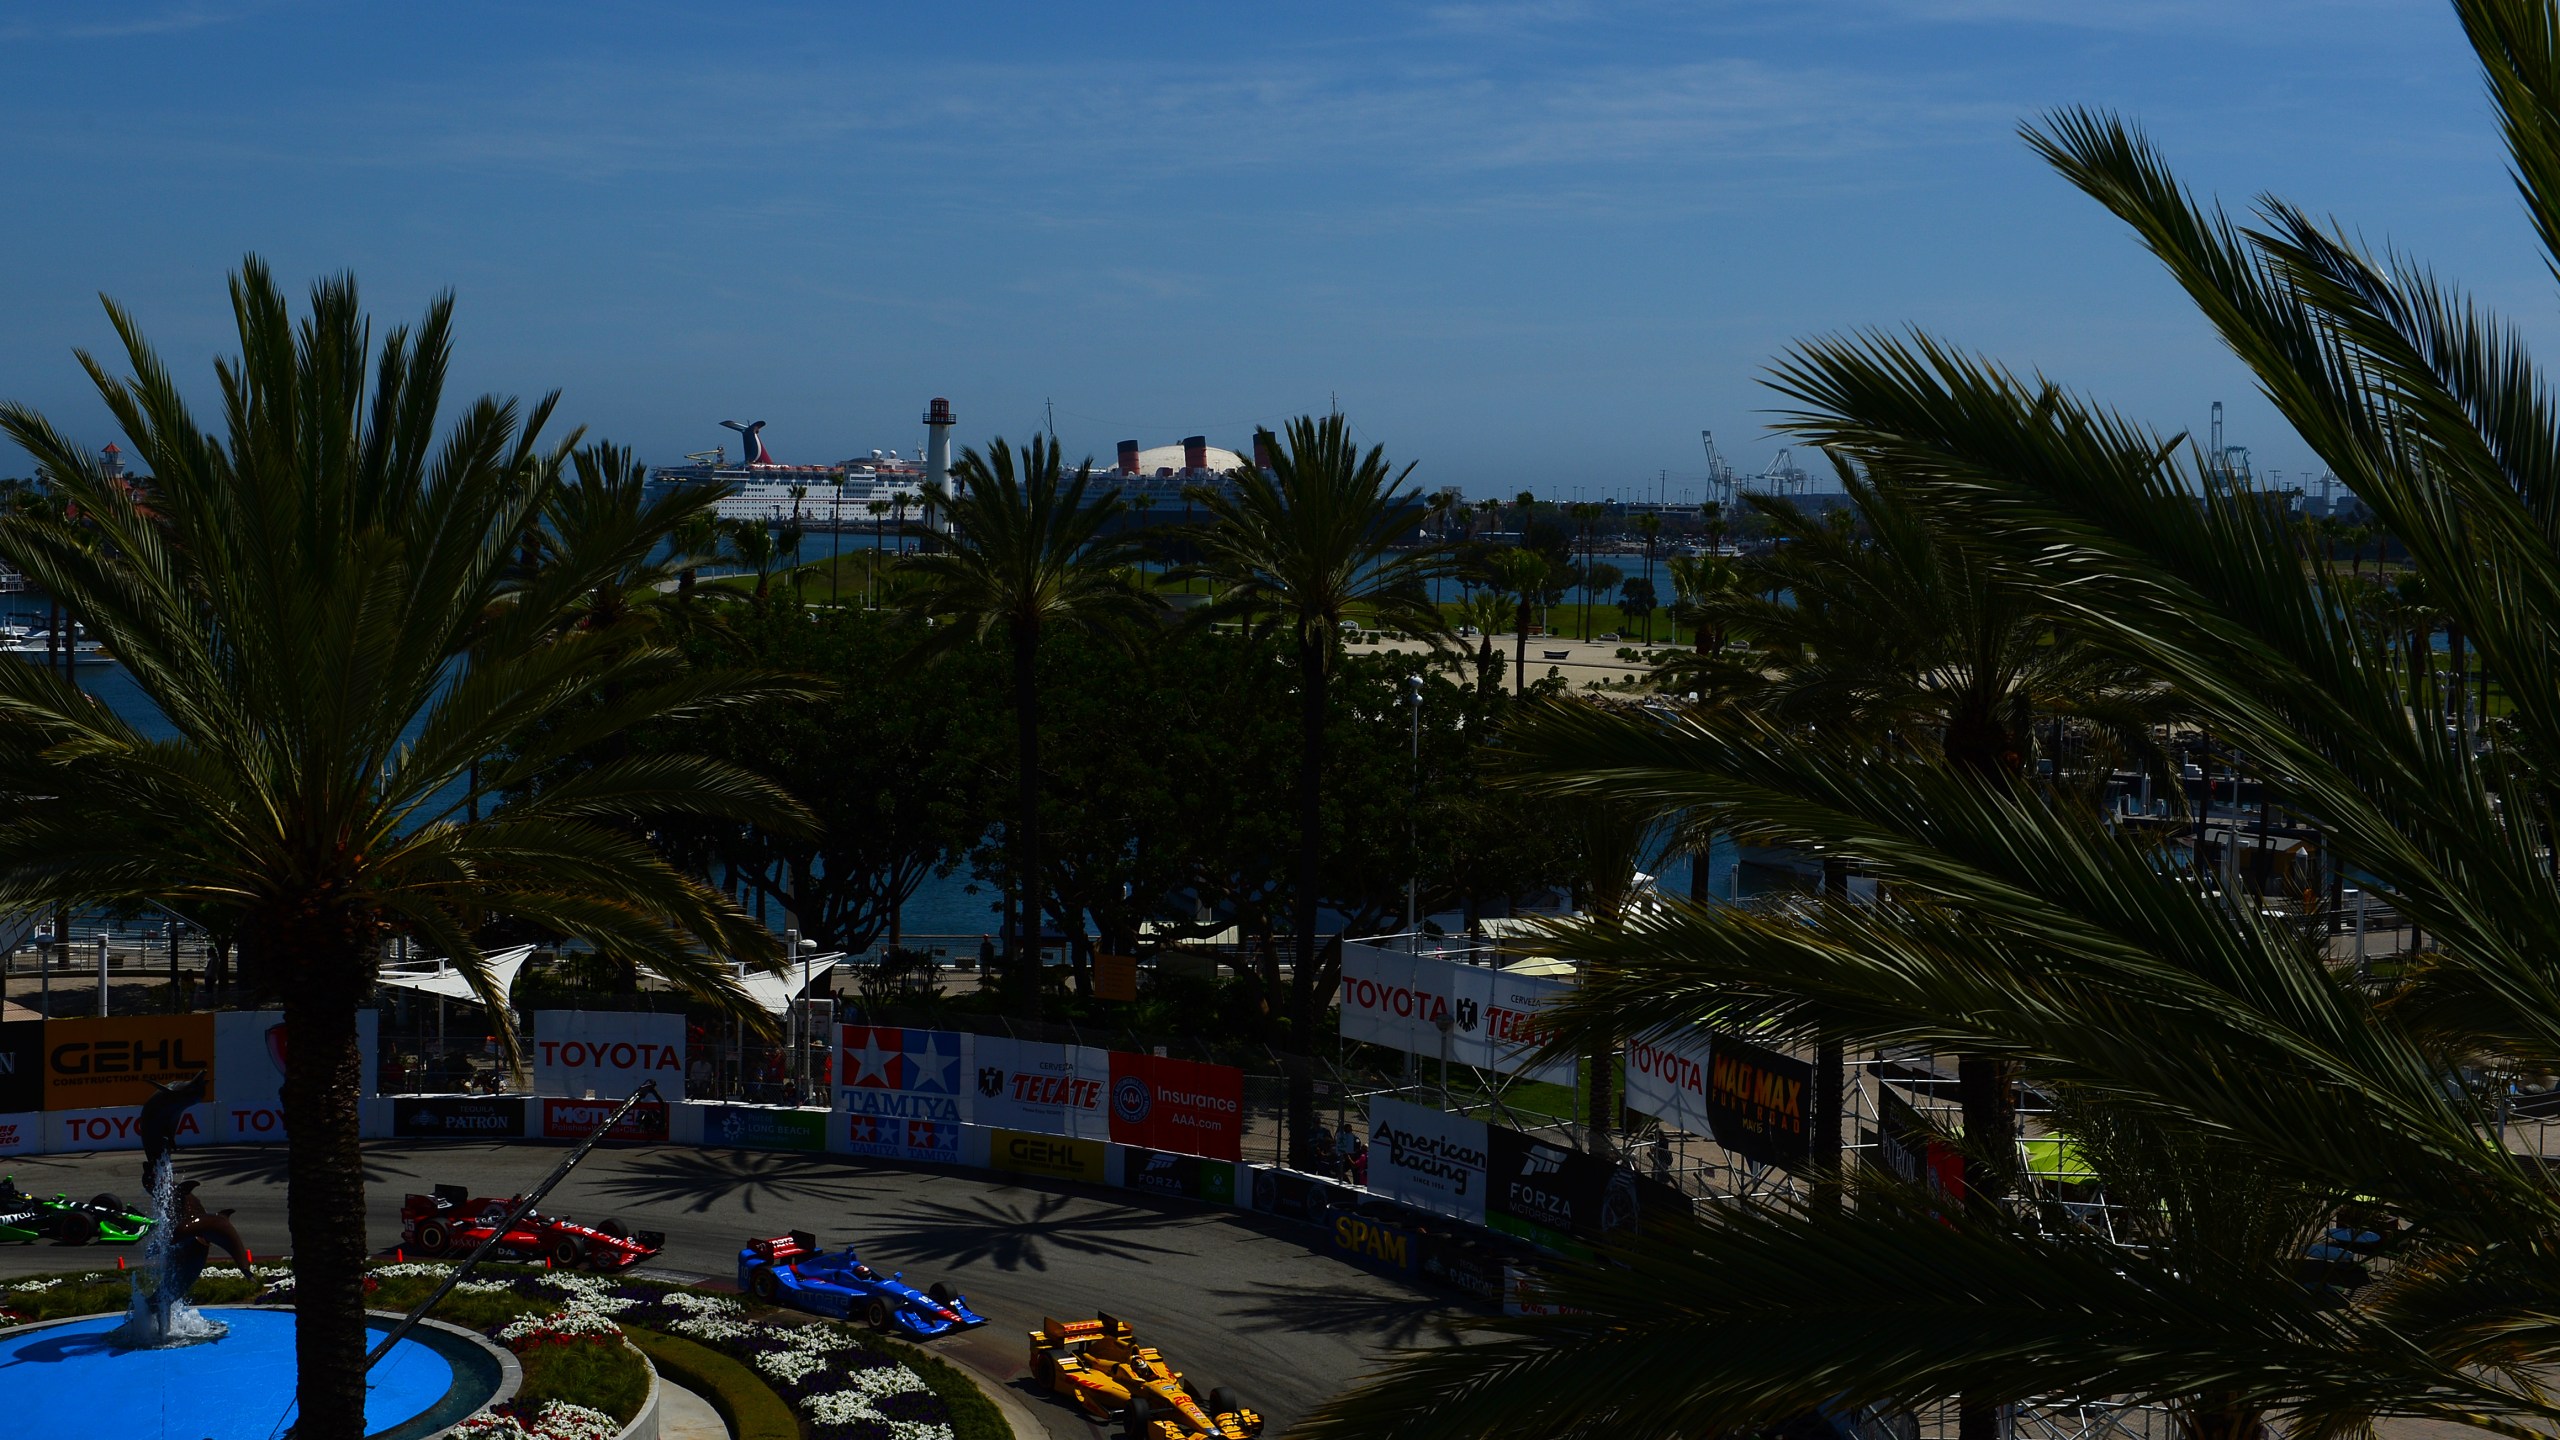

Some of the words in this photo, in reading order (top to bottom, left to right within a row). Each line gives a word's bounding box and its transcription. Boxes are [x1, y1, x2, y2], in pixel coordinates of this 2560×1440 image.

[1342, 976, 1449, 1023] TOYOTA
[1509, 994, 1541, 1008] CERVEZA
[51, 1037, 208, 1075] GEHL
[538, 1041, 682, 1071] TOYOTA
[1039, 1061, 1074, 1072] CERVEZA
[1629, 1038, 1703, 1096] TOYOTA
[53, 1074, 139, 1087] CONSTRUCTION
[1009, 1072, 1102, 1110] TECATE
[1712, 1051, 1753, 1101] MAD
[1753, 1067, 1802, 1120] MAX
[459, 1104, 495, 1114] TEQUILA
[841, 1089, 962, 1122] TAMIYA
[1122, 1092, 1141, 1105] AAA
[1156, 1084, 1238, 1113] Insurance
[1712, 1087, 1748, 1117] FURY
[1756, 1105, 1801, 1136] ROAD
[66, 1113, 201, 1141] TOYA
[748, 1124, 774, 1133] LONG
[778, 1126, 810, 1136] BEACH
[1171, 1112, 1222, 1131] AAA.com
[850, 1141, 900, 1157] TAMIYA
[907, 1148, 958, 1163] TAMIYA
[1009, 1138, 1085, 1168] GEHL
[1373, 1119, 1487, 1169] American
[1138, 1173, 1184, 1191] FORZA
[1389, 1142, 1468, 1196] Racing
[1509, 1181, 1572, 1219] FORZA
[404, 1218, 416, 1232] 15
[1508, 1200, 1572, 1233] MOTORSPORT
[1335, 1215, 1408, 1270] SPAM
[1173, 1395, 1194, 1407] 28
